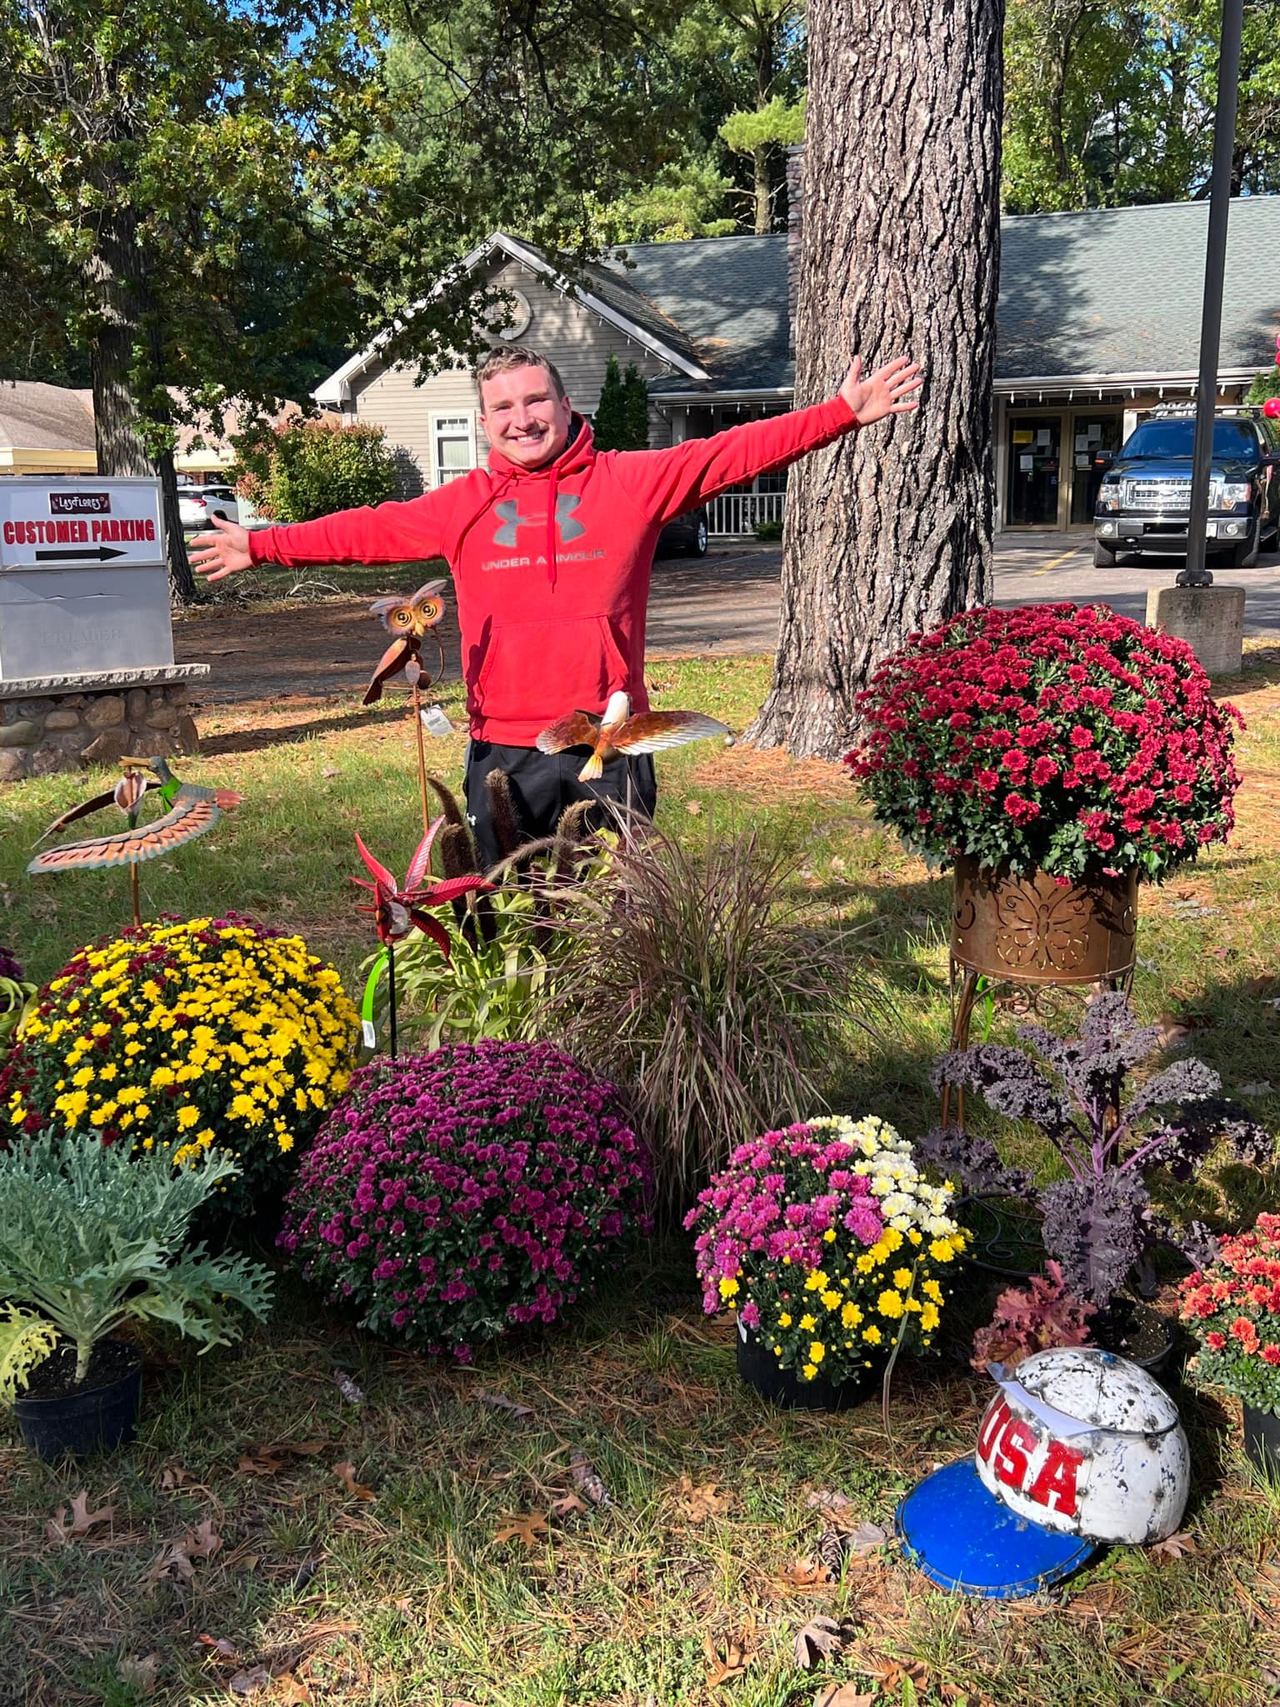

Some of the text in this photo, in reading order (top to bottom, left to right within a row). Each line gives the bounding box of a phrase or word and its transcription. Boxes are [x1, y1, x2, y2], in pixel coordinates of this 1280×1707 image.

[3, 519, 155, 544] CUSTOMER PARKING
[481, 549, 605, 571] UNDER AMOUR
[978, 1396, 1085, 1517] USA
